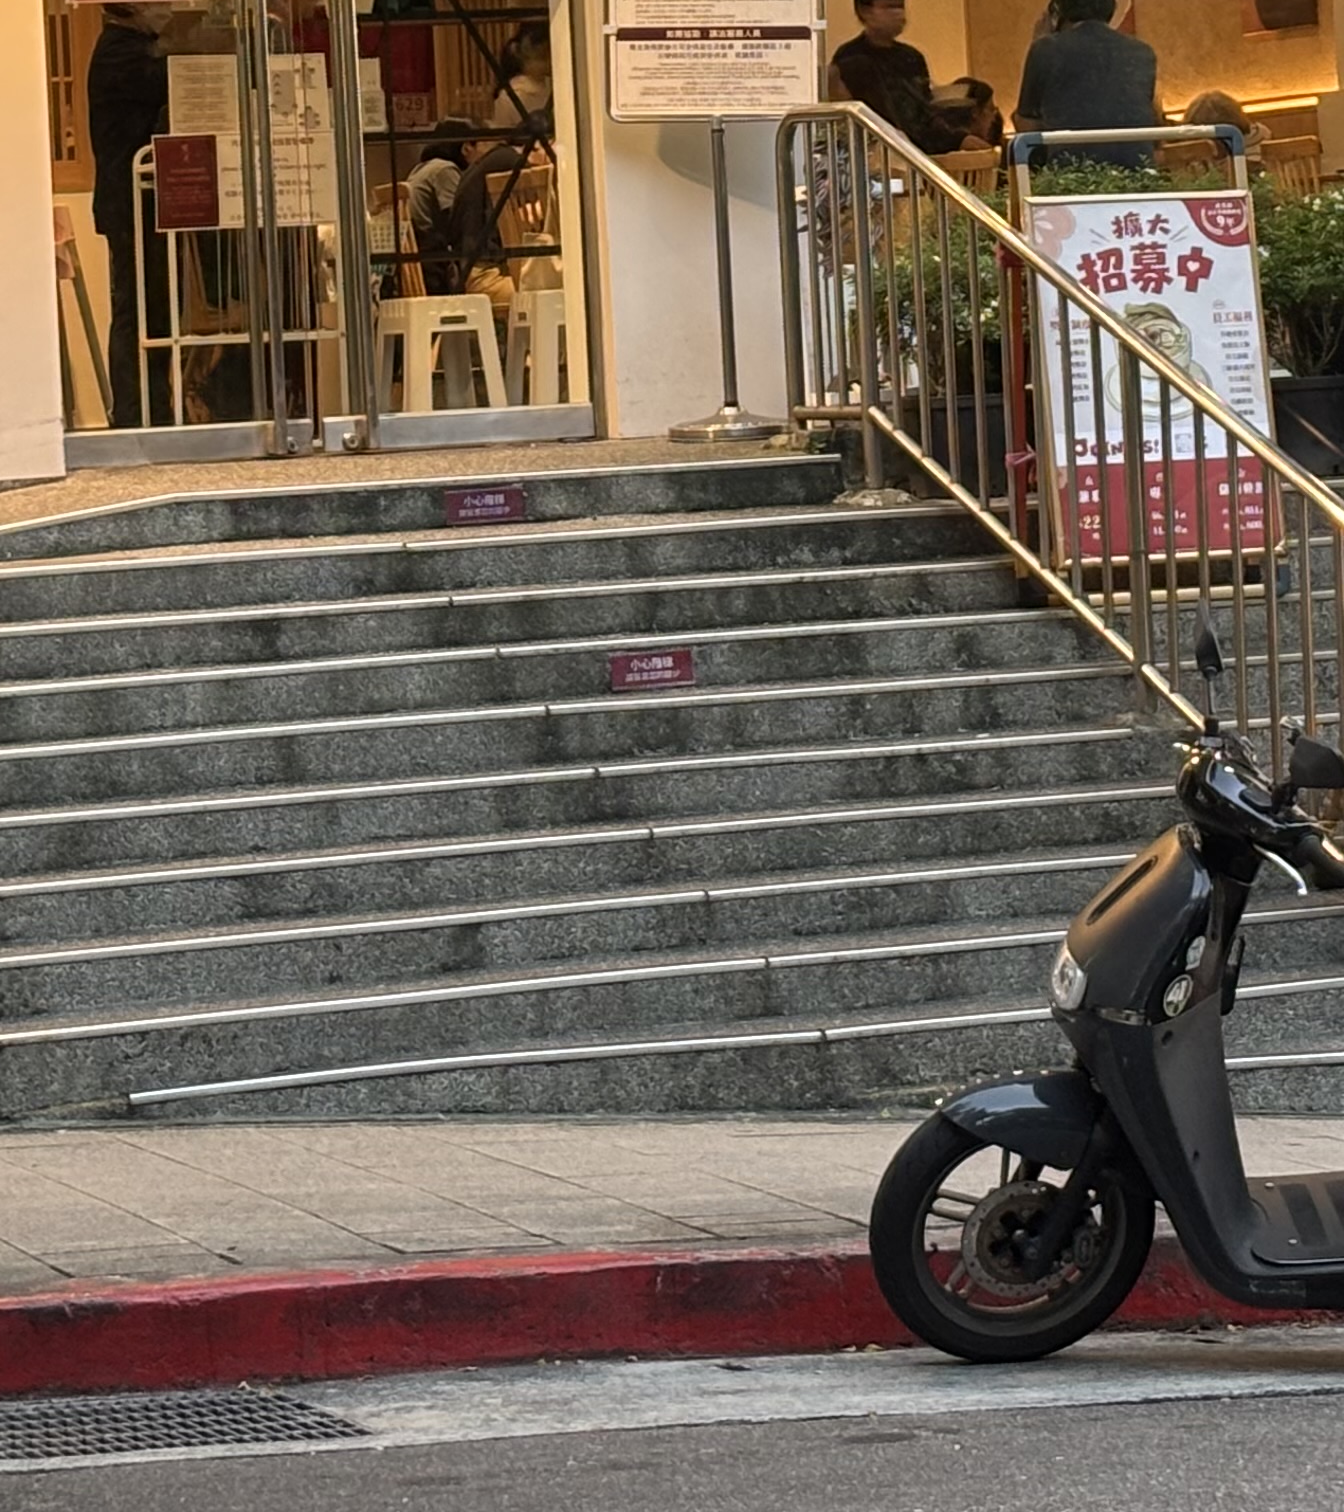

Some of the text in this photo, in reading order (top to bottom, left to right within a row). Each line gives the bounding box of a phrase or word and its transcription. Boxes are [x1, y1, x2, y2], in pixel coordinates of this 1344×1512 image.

[1111, 211, 1171, 239] 擴大
[1076, 241, 1214, 295] 招募中
